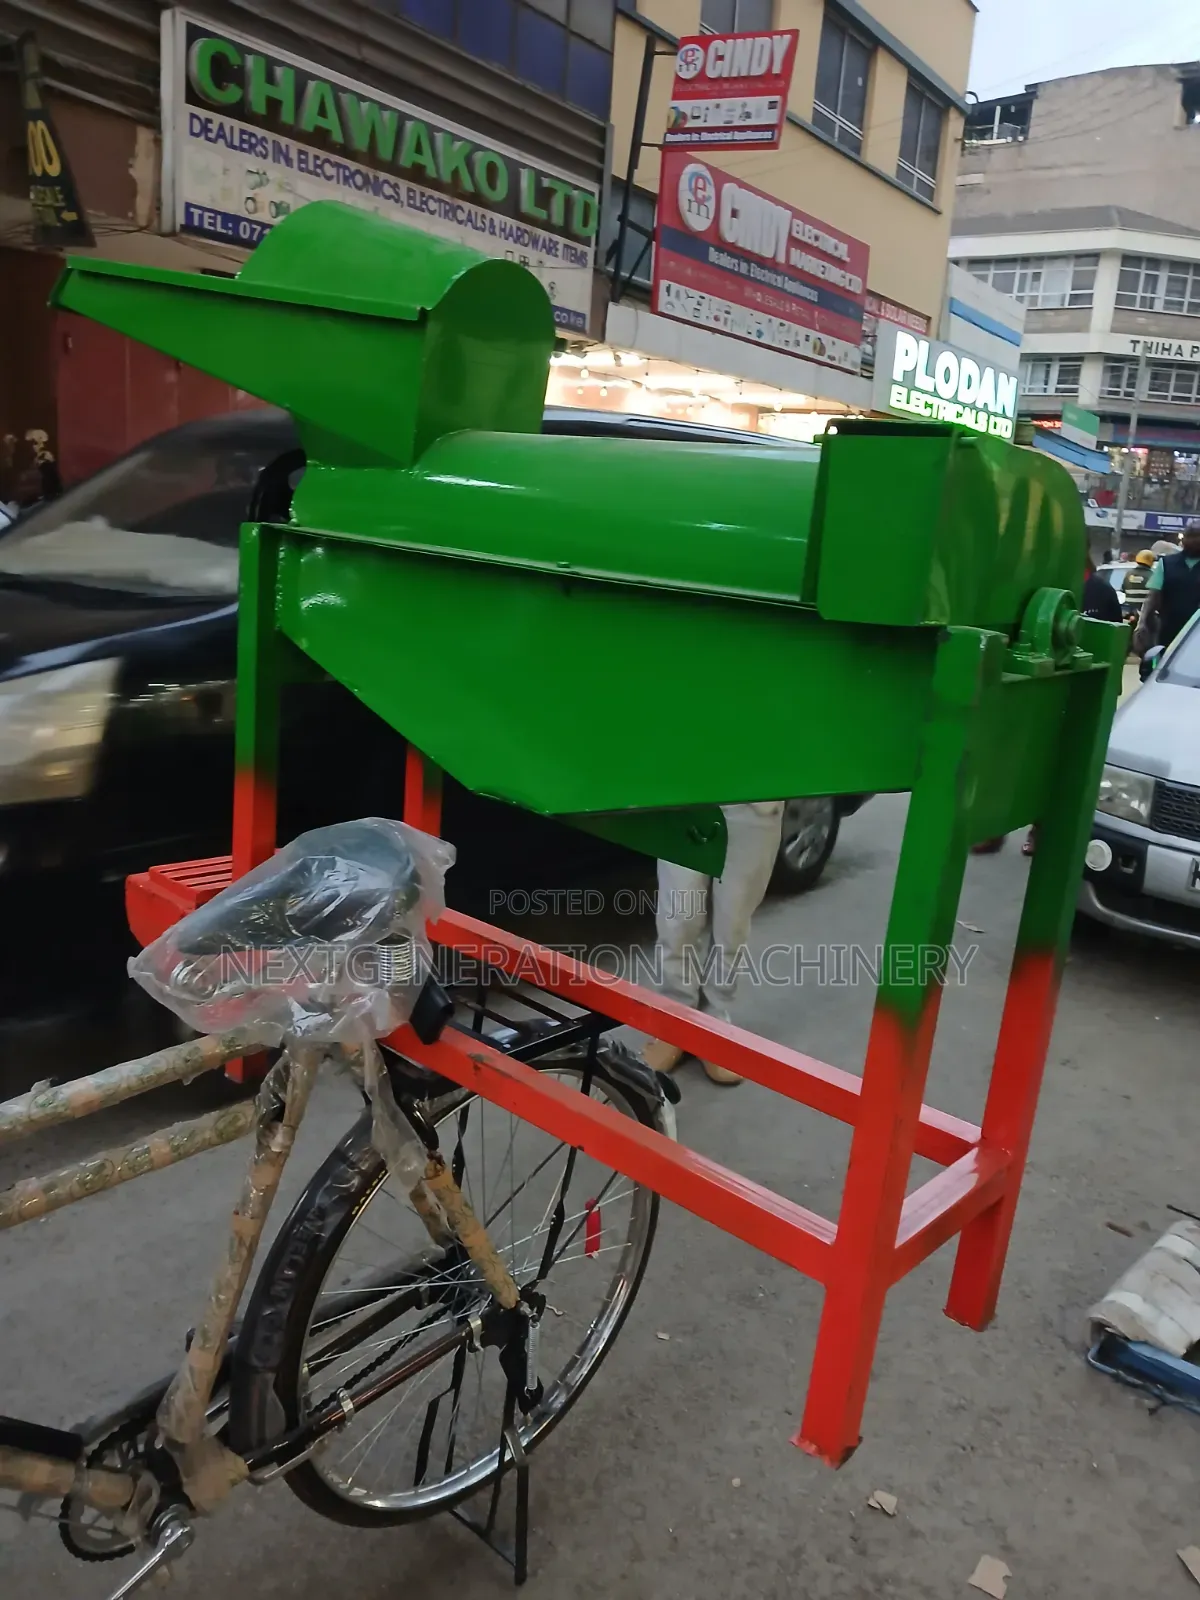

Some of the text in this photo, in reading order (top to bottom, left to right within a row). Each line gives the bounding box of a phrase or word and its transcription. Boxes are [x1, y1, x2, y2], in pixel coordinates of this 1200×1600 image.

[705, 34, 792, 78] CINDY
[189, 38, 598, 237] CHAWAKO LTD
[189, 112, 269, 161] DEALERS
[297, 148, 404, 209] ELECTRONICS,
[406, 186, 487, 233] ELECTRICALS
[488, 217, 497, 236] &
[499, 218, 559, 258] HARDWARE
[562, 241, 589, 268] ITEMS
[189, 207, 234, 235] TEL:
[719, 182, 792, 264] CINDY
[792, 218, 851, 262] ELECTRICAL
[708, 246, 739, 272] Dealers
[750, 262, 784, 288] Electrical
[784, 276, 819, 302] Appliances
[789, 247, 863, 294] MARKETING LTD
[892, 330, 1018, 418] PLODAN
[889, 383, 1013, 439] ELECTRICALS LTD
